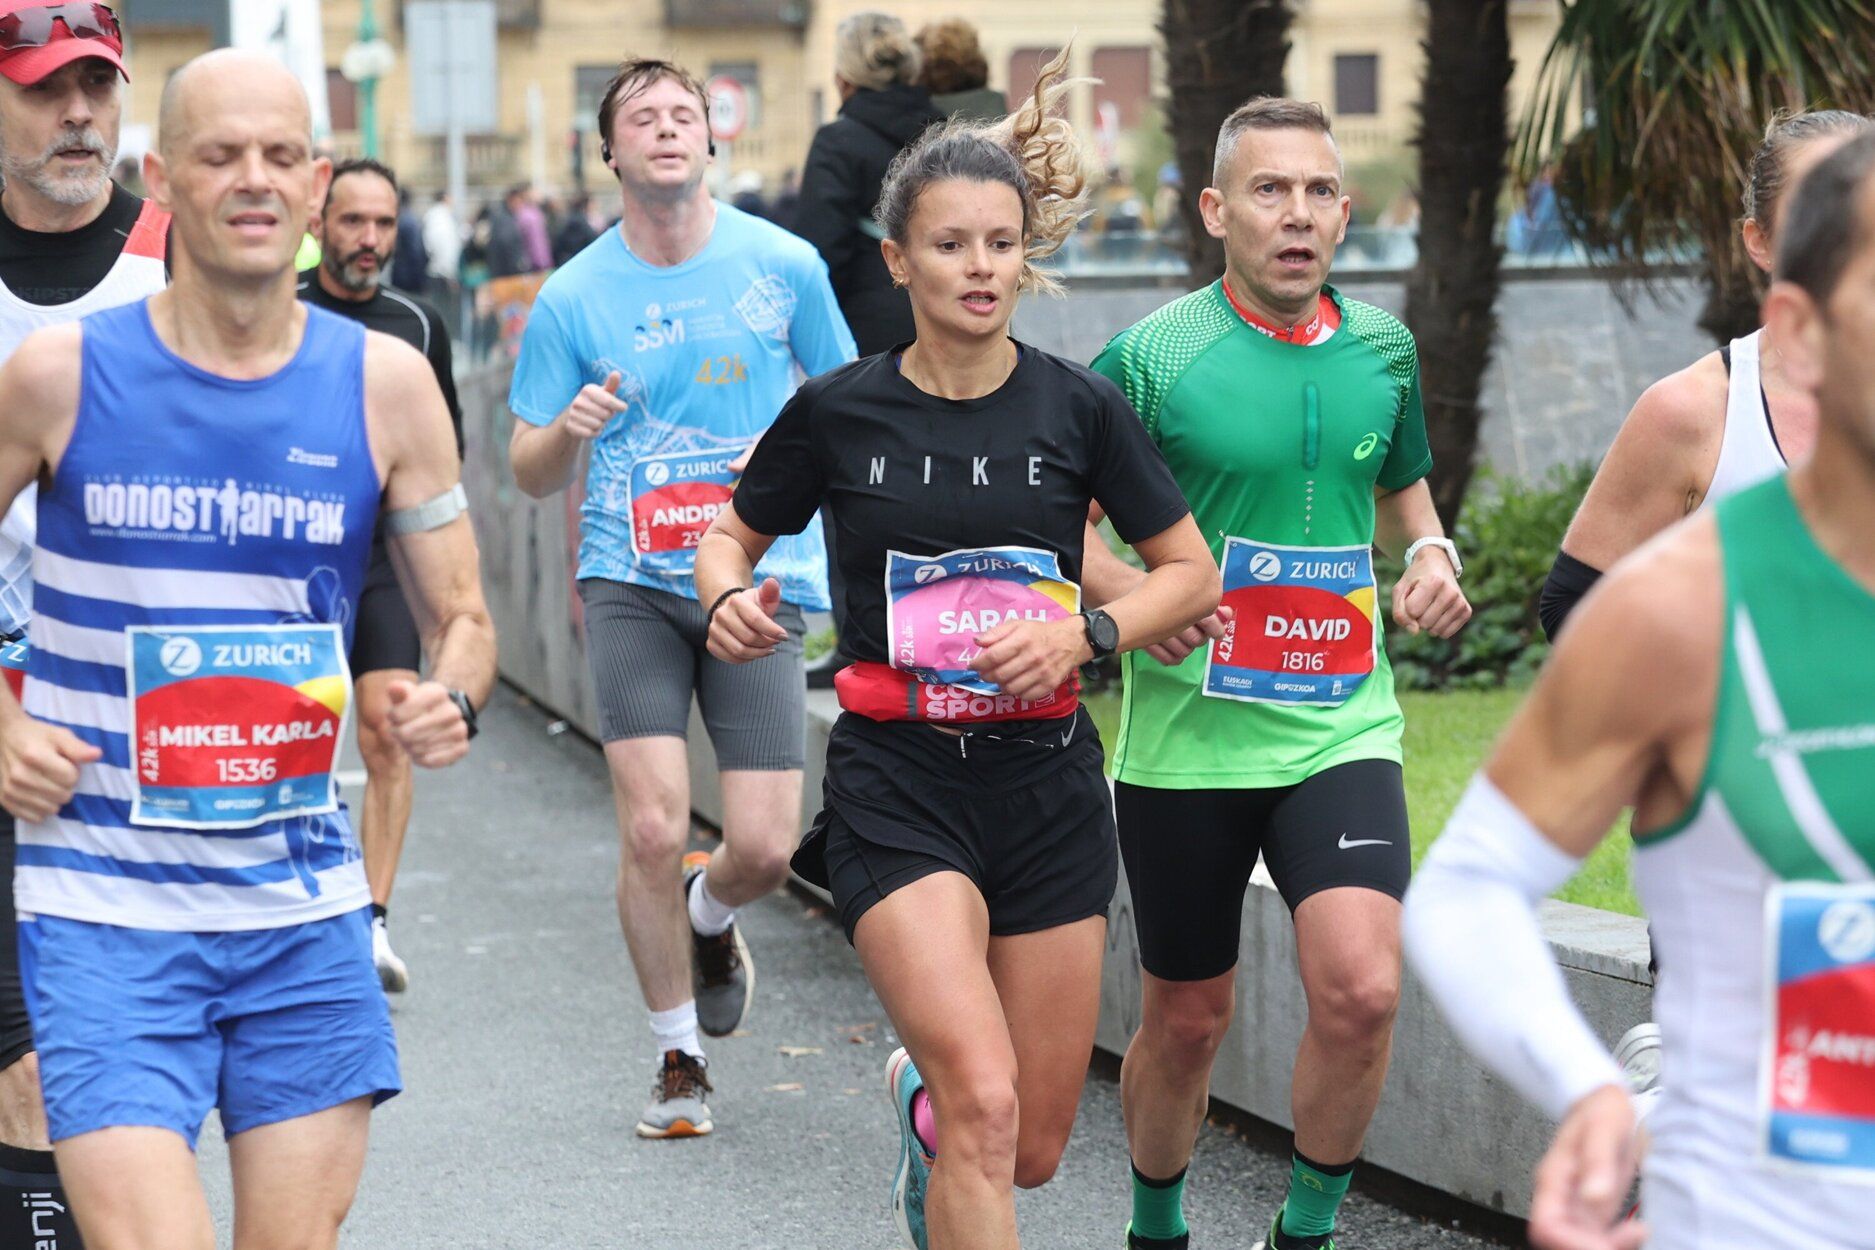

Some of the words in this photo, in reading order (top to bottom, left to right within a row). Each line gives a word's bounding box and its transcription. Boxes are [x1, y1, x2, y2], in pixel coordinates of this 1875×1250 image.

[634, 319, 685, 352] SSM
[696, 352, 748, 384] 42k
[869, 456, 1042, 486] NIKE
[1290, 561, 1357, 580] ZURICH
[1264, 615, 1351, 641] DAVID
[212, 643, 312, 667] ZURICH
[1282, 651, 1324, 671] 1816
[926, 695, 1029, 719] SPORT
[160, 724, 247, 748] MIKEL
[253, 719, 334, 746] KARLA
[215, 758, 277, 782] 1536
